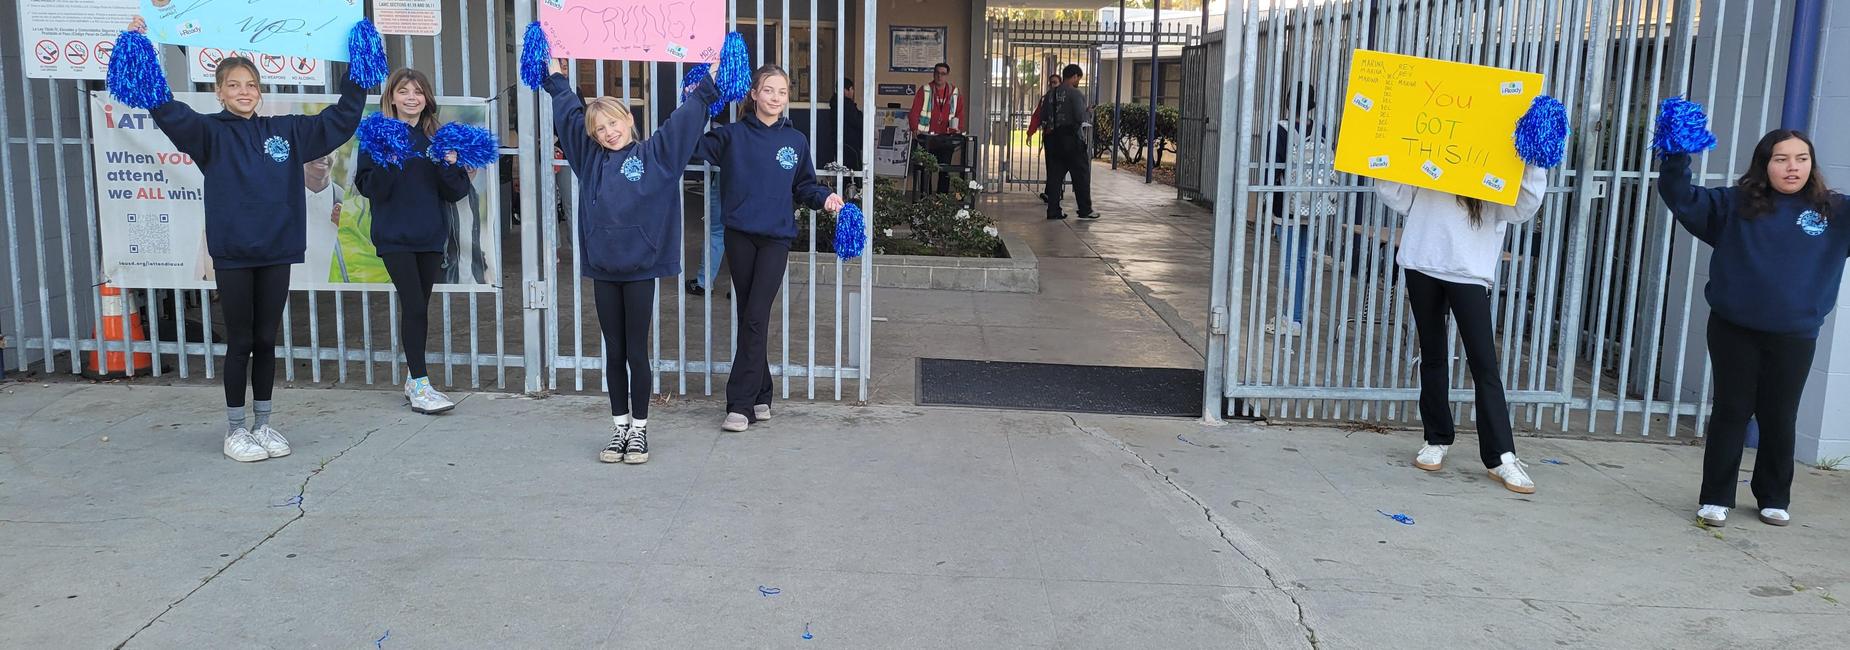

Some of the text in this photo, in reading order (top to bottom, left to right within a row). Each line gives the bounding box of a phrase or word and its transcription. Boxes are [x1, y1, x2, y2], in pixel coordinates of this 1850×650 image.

[667, 48, 685, 59] i-Ready
[1354, 98, 1369, 110] i-Ready
[1416, 112, 1462, 139] GOT
[106, 151, 193, 165] When YOU
[1402, 138, 1489, 166] THIS!!!
[107, 170, 168, 184] attend,
[1422, 164, 1438, 179] i-Ready
[1484, 178, 1502, 190] i-Ready
[108, 187, 202, 200] we ALL win!
